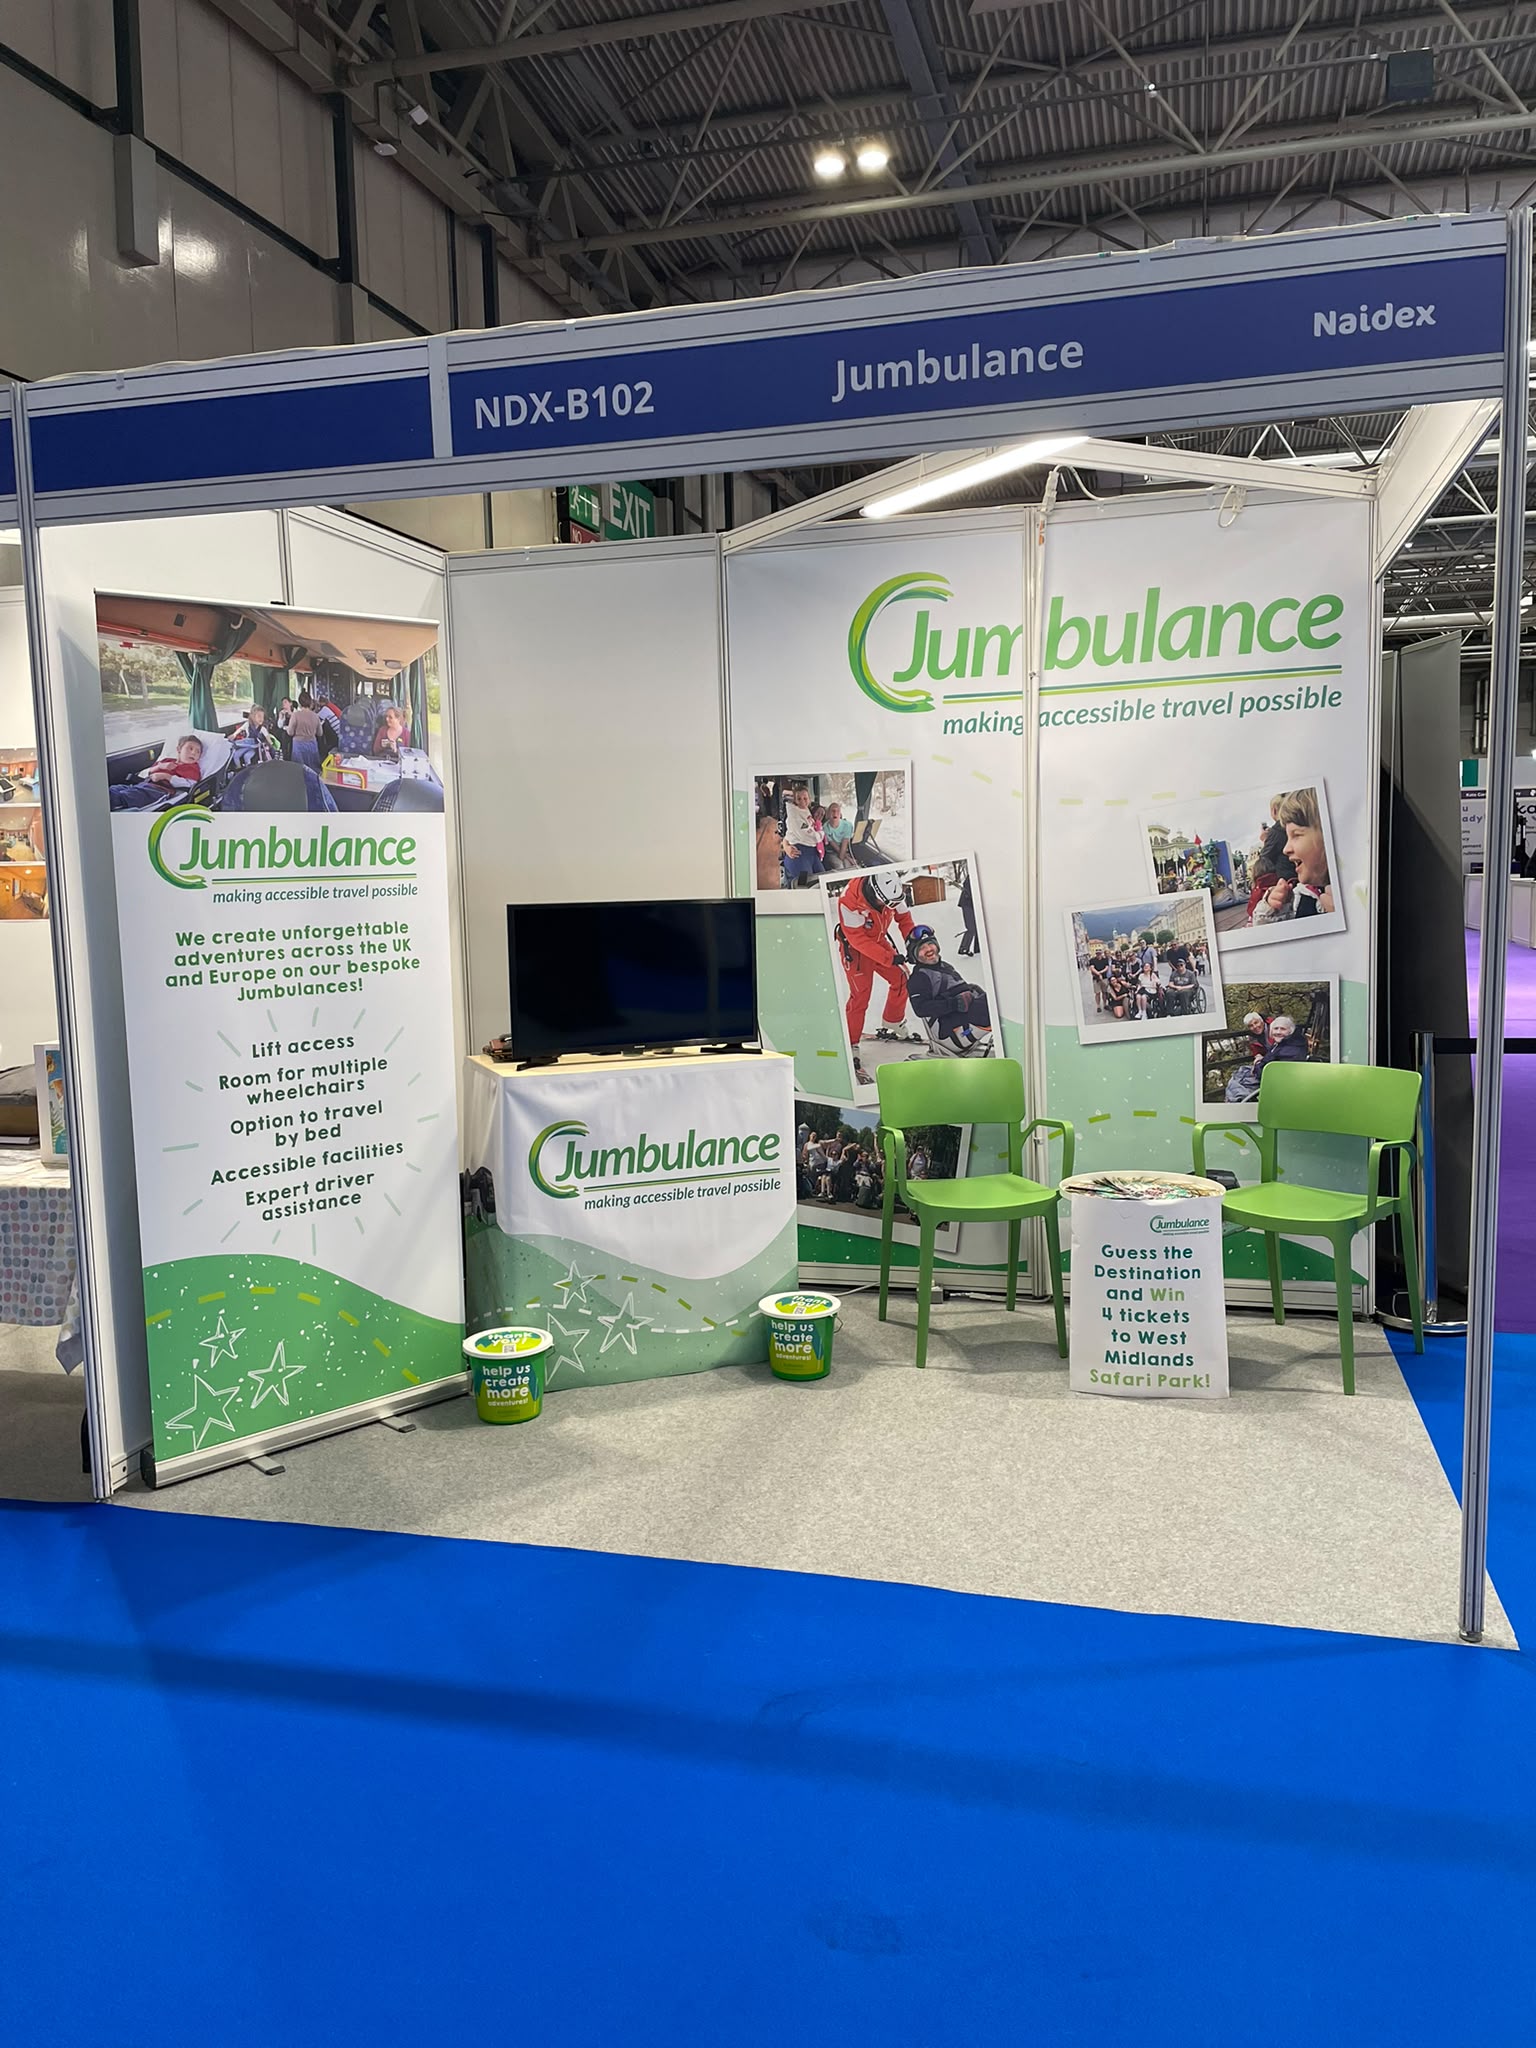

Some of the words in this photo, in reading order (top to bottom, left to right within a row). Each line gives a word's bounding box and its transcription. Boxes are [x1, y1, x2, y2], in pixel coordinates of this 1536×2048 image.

[1313, 302, 1437, 337] Naidex
[832, 340, 1085, 403] Jumbulance
[474, 381, 655, 430] NDX-B102
[609, 481, 651, 538] EXIT
[893, 587, 1345, 683] Jumbulance
[942, 709, 1024, 736] making
[1039, 698, 1157, 728] accessible
[1161, 691, 1235, 719] travel
[1239, 685, 1344, 718] possible
[178, 825, 417, 871] Jumbulance
[213, 889, 262, 905] making
[265, 886, 330, 902] accessible
[332, 884, 369, 899] travel
[371, 883, 418, 900] possible
[175, 931, 206, 947] We
[211, 927, 276, 945] create
[282, 921, 409, 941] unforgettable
[174, 948, 285, 967] adventures
[291, 942, 354, 959] across
[359, 939, 388, 956] the
[392, 938, 412, 953] UK
[165, 970, 203, 988] and
[209, 966, 277, 985] Europe
[282, 966, 304, 979] on
[309, 963, 341, 977] our
[347, 956, 421, 975] bespoke
[237, 978, 363, 1002] Jumbulances!
[252, 1040, 282, 1058] Lift
[287, 1036, 355, 1054] access
[219, 1072, 272, 1090] Room
[277, 1067, 305, 1083] for
[312, 1057, 388, 1078] multiple
[247, 1078, 366, 1105] wheelchairs
[230, 1113, 294, 1136] Option
[299, 1110, 319, 1125] to
[324, 1099, 383, 1121] travel
[275, 1132, 299, 1147] by
[305, 1123, 342, 1142] bed
[210, 1155, 316, 1186] Accessible
[322, 1142, 404, 1166] facilities
[555, 1129, 780, 1182] Jumbulance
[245, 1180, 310, 1206] Expert
[315, 1171, 376, 1193] driver
[584, 1194, 631, 1210] making
[633, 1186, 695, 1205] accessible
[696, 1183, 731, 1199] travel
[733, 1177, 782, 1196] possible
[262, 1192, 362, 1221] assistance
[1156, 1217, 1210, 1229] Jumbulance
[1101, 1244, 1157, 1260] Guess
[1164, 1246, 1193, 1260] the
[1094, 1264, 1201, 1281] Destination
[793, 1295, 830, 1305] thank
[1106, 1287, 1143, 1301] and
[1150, 1287, 1185, 1302] Win
[771, 1320, 796, 1333] help
[799, 1323, 814, 1332] us
[1102, 1307, 1113, 1321] 4
[1119, 1308, 1190, 1324] tickets
[488, 1331, 533, 1340] thank
[491, 1337, 528, 1347] you!
[773, 1331, 813, 1342] create
[774, 1342, 812, 1353] more
[1111, 1329, 1131, 1343] to
[1138, 1330, 1187, 1345] West
[482, 1365, 512, 1377] help
[516, 1364, 531, 1374] us
[1104, 1350, 1194, 1367] Midlands
[485, 1375, 530, 1387] create
[1089, 1369, 1151, 1387] Safari
[1157, 1373, 1210, 1388] Park!
[486, 1387, 529, 1398] more
